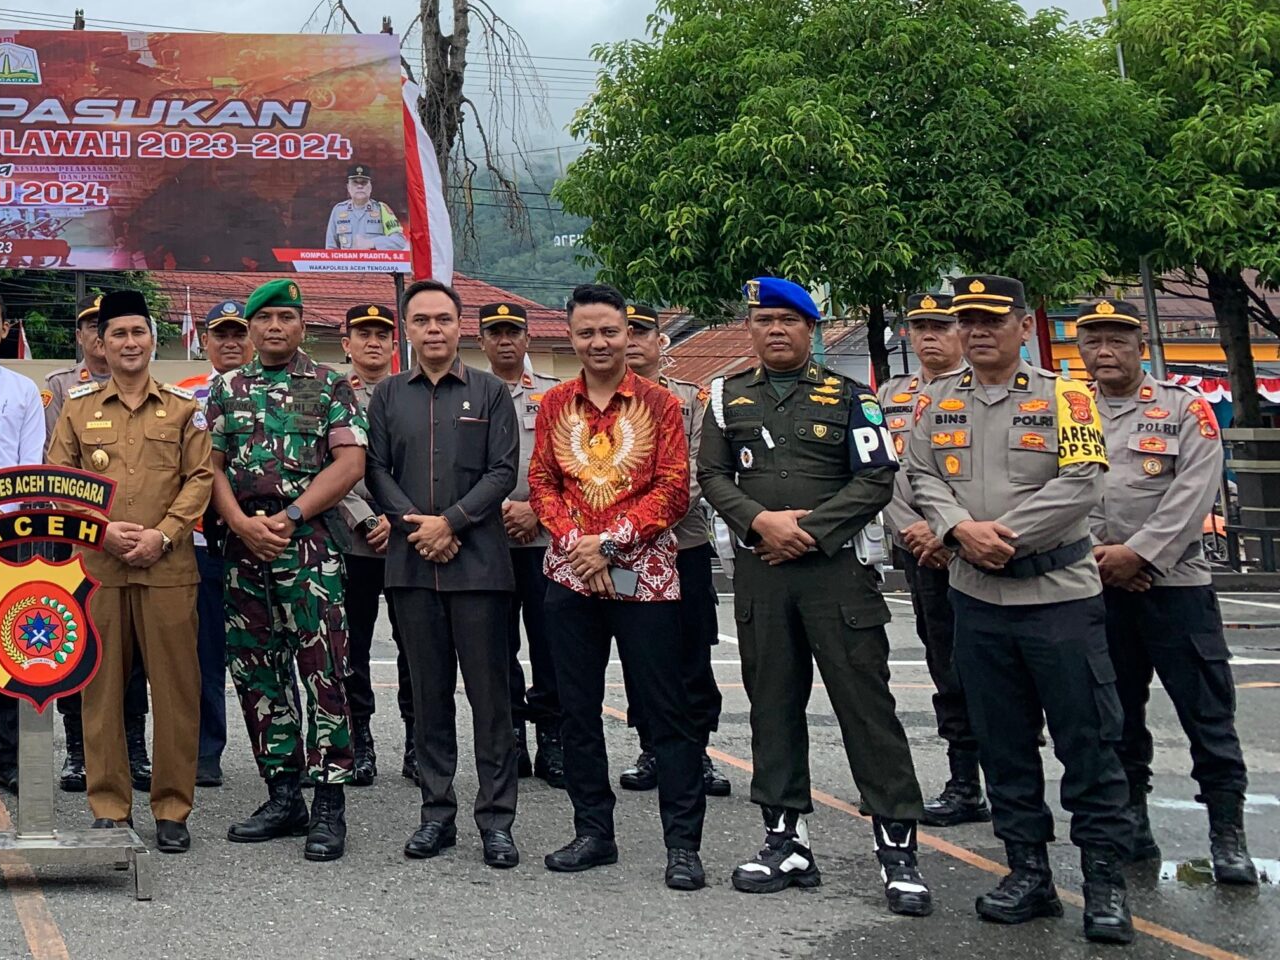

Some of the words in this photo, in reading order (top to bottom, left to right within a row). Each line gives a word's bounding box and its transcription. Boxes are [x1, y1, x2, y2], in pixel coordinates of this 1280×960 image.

[137, 131, 353, 160] 2023-2024
[22, 181, 109, 206] 2024
[935, 414, 967, 425] BINS
[1013, 416, 1053, 426] POLRI
[1137, 423, 1179, 436] POLRI
[15, 475, 44, 494] ACEH
[47, 475, 104, 505] TENGGARA
